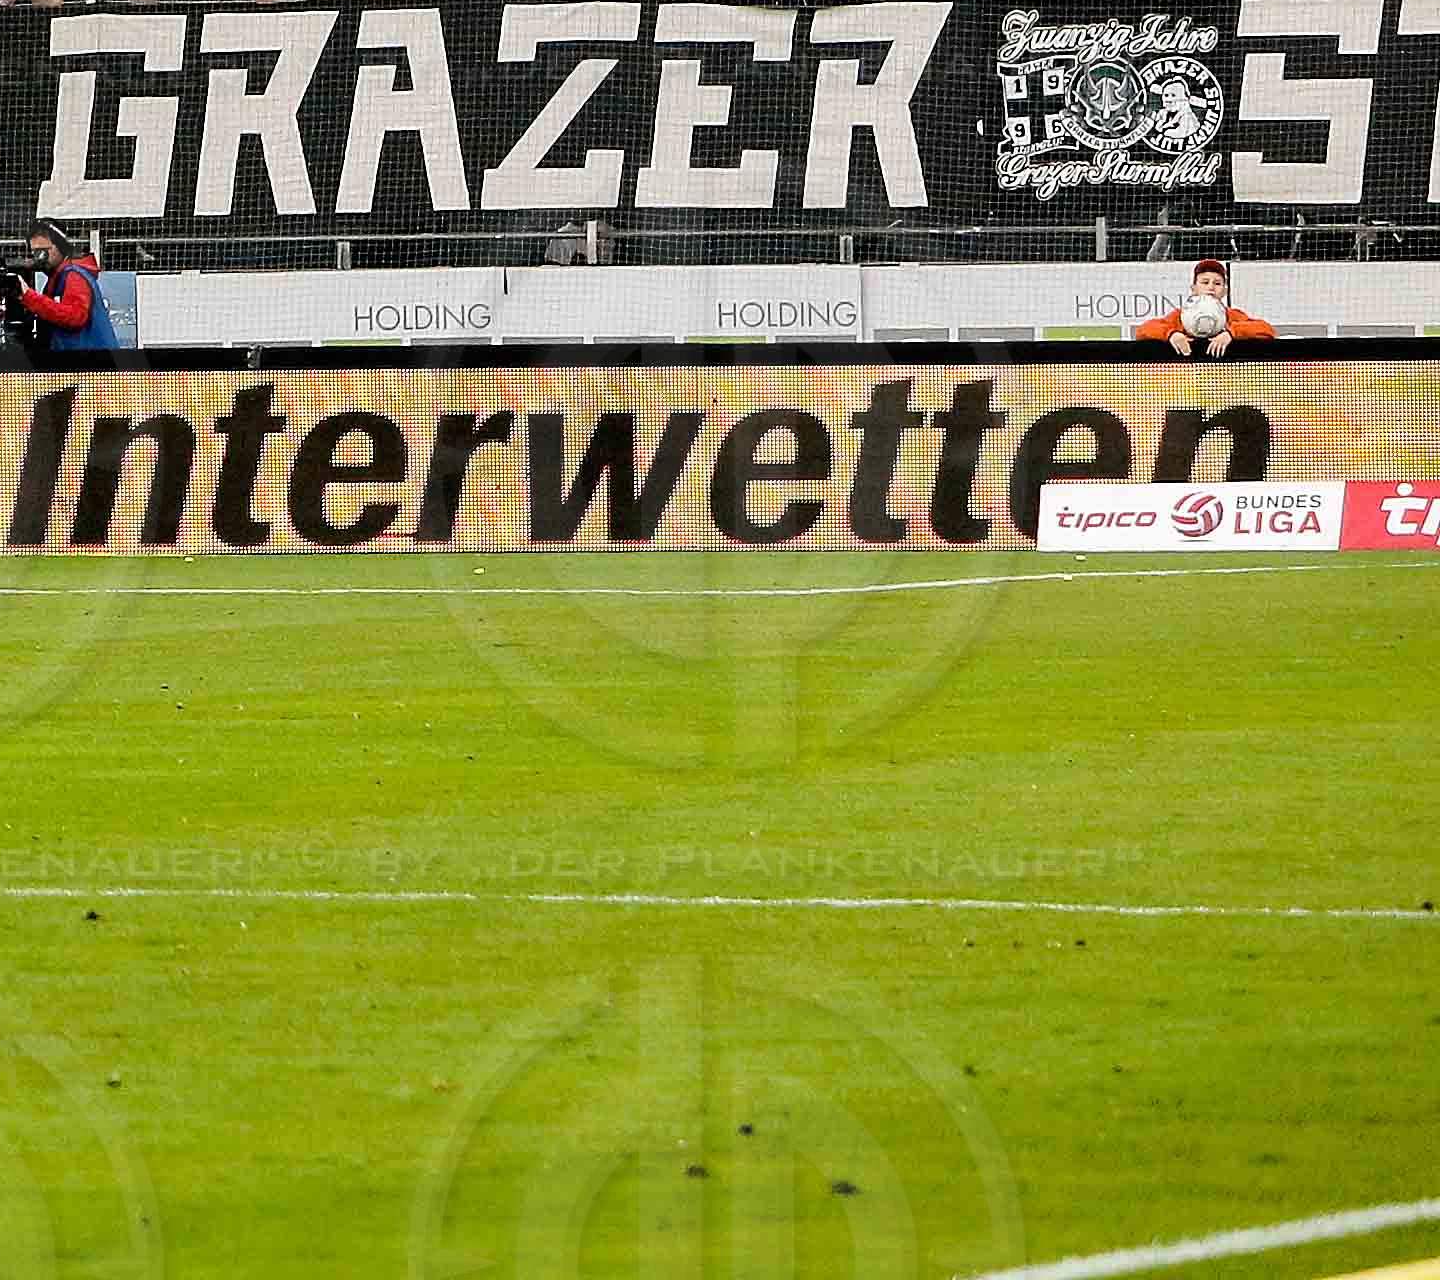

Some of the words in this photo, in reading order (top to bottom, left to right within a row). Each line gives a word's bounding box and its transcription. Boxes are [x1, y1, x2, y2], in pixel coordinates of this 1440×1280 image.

[1129, 12, 1219, 55] Jahre
[36, 2, 953, 219] GRAZER
[997, 152, 1093, 201] Grazer
[1092, 148, 1222, 193] Sturmflut
[353, 302, 492, 334] HOLDING
[718, 301, 858, 330] HOLDING
[1074, 294, 1183, 320] HOLDIN
[7, 376, 1274, 547] Interwetten
[1234, 492, 1325, 511] BUNDES
[1055, 504, 1158, 533] tipico
[1233, 509, 1323, 536] LIGA
